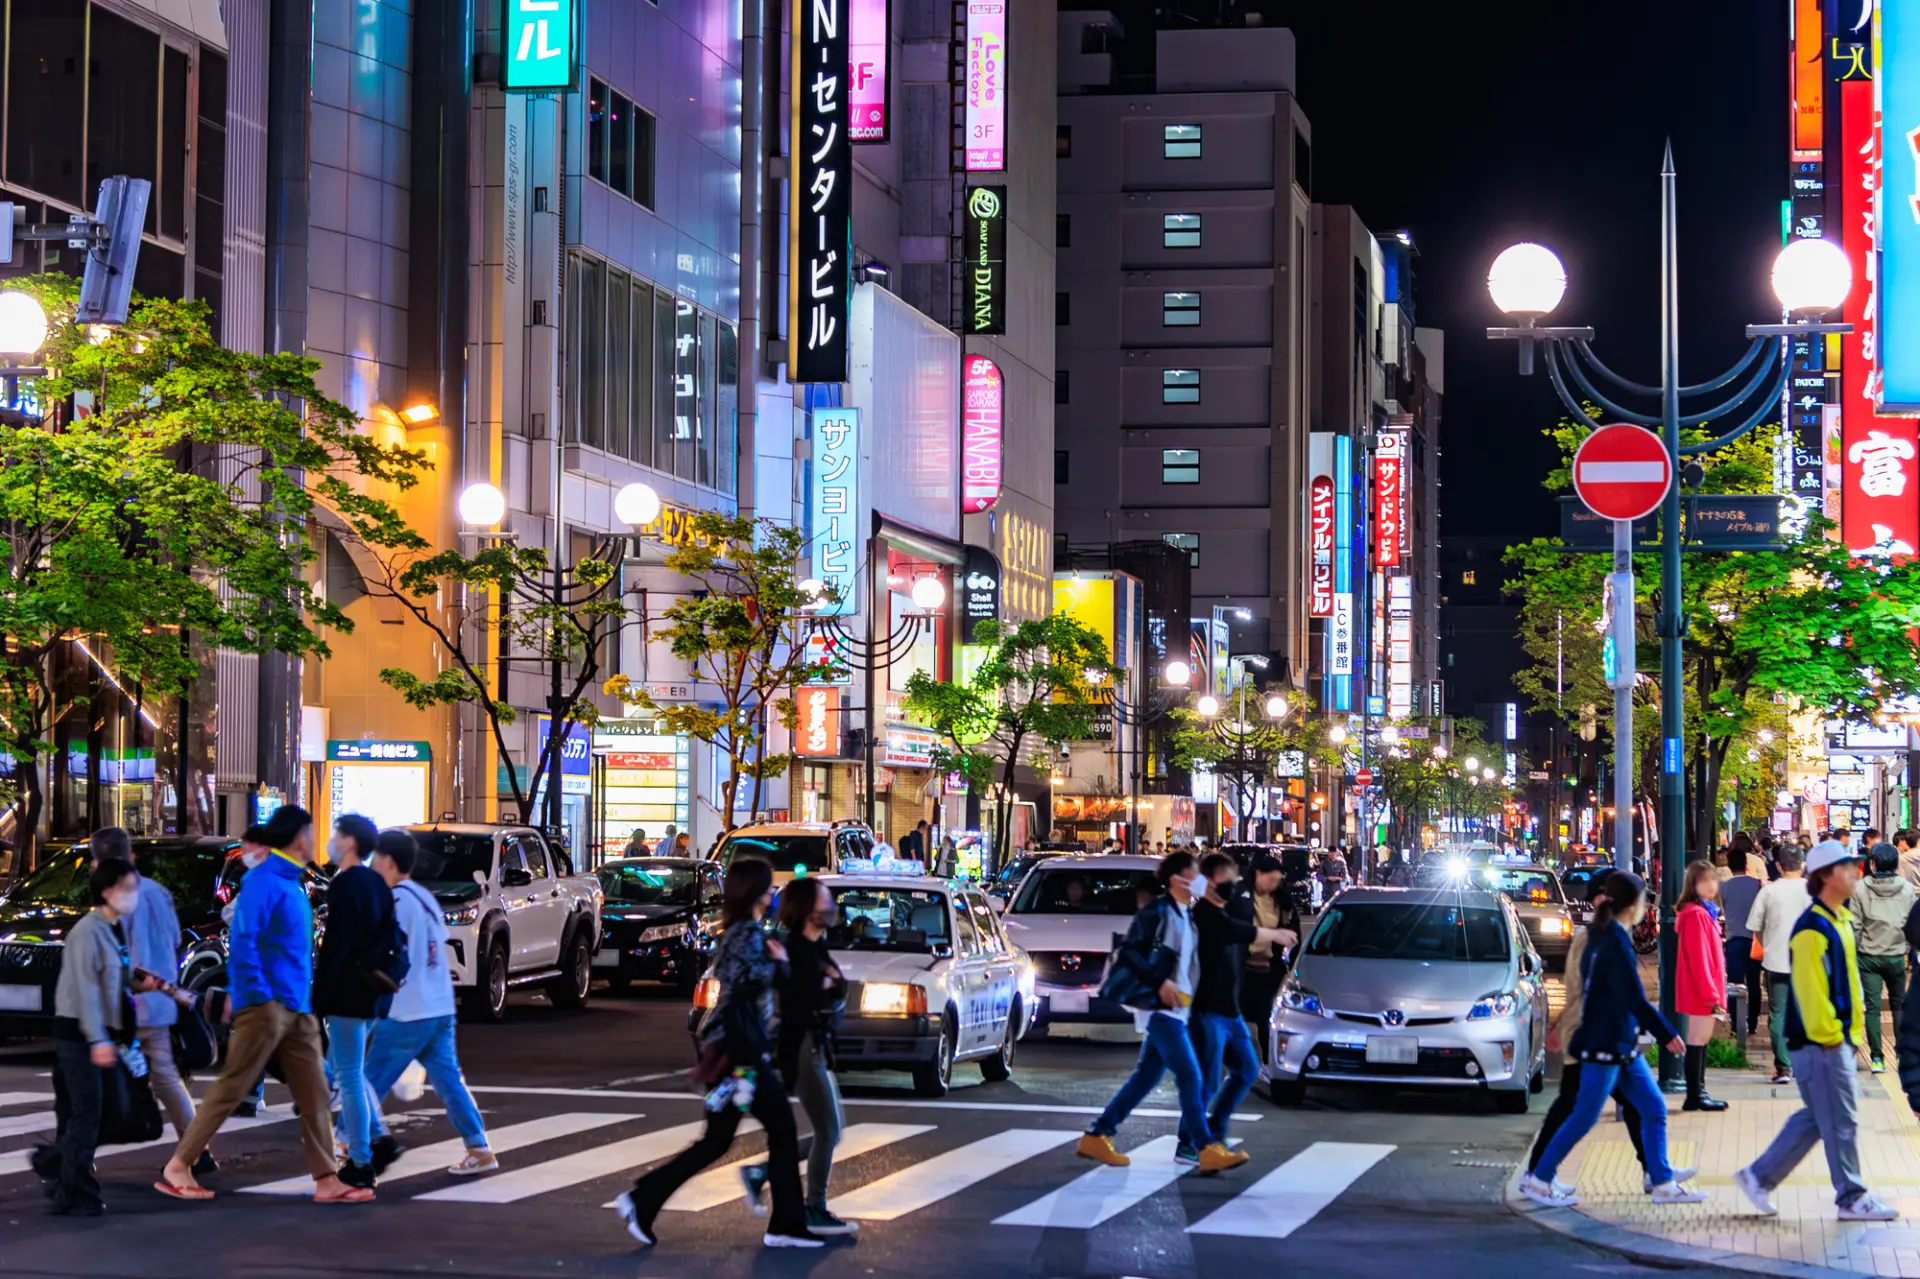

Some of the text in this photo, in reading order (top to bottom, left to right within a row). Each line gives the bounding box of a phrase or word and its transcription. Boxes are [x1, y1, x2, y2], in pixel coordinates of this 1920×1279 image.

[970, 37, 983, 108] Factory
[985, 44, 1000, 101] Love
[973, 124, 995, 139] 3F
[505, 124, 520, 284] http://www.sps-gr.com
[980, 220, 988, 243] SOAP
[975, 268, 991, 331] DIANA
[971, 359, 993, 375] 5F
[966, 408, 999, 483] HANABI
[1312, 485, 1332, 613] メイプル通りビル
[968, 602, 994, 611] Sapporo
[971, 592, 991, 602] Shell
